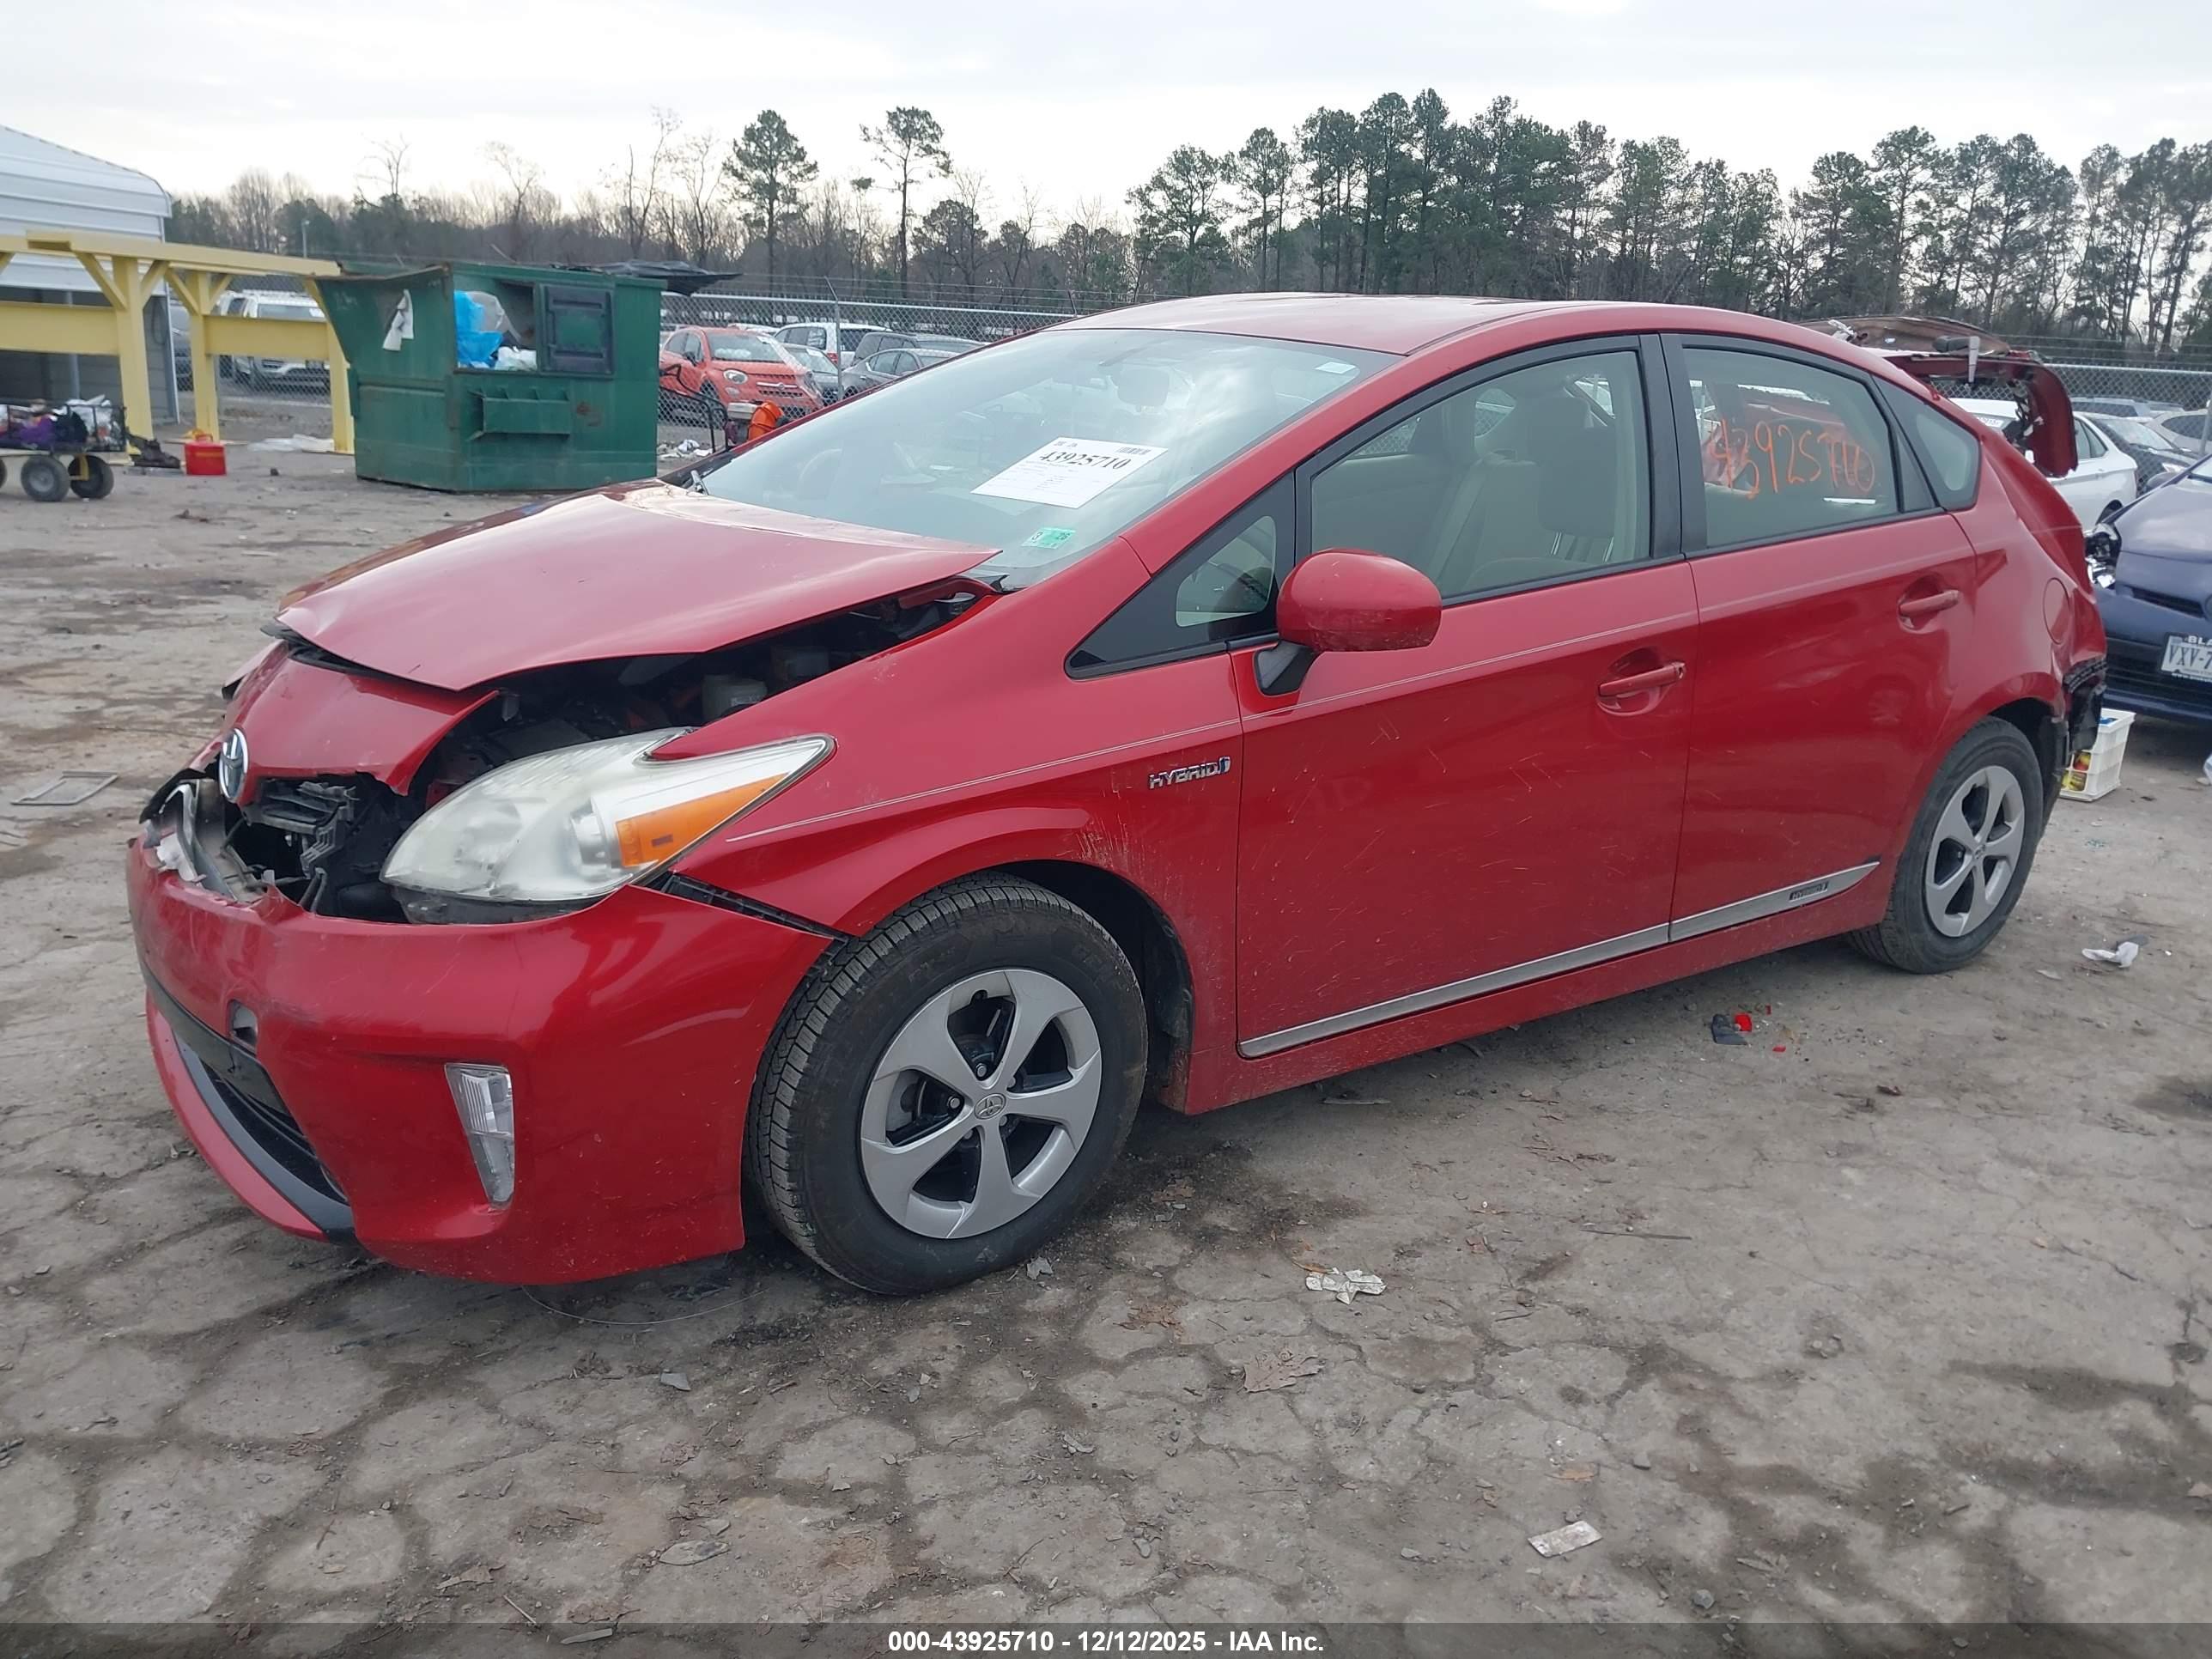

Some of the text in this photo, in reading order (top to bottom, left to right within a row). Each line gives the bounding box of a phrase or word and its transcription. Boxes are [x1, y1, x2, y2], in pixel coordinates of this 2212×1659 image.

[1039, 451, 1132, 470] 43925710
[1707, 419, 1875, 500] 43925710
[1149, 762, 1221, 789] HYBRID
